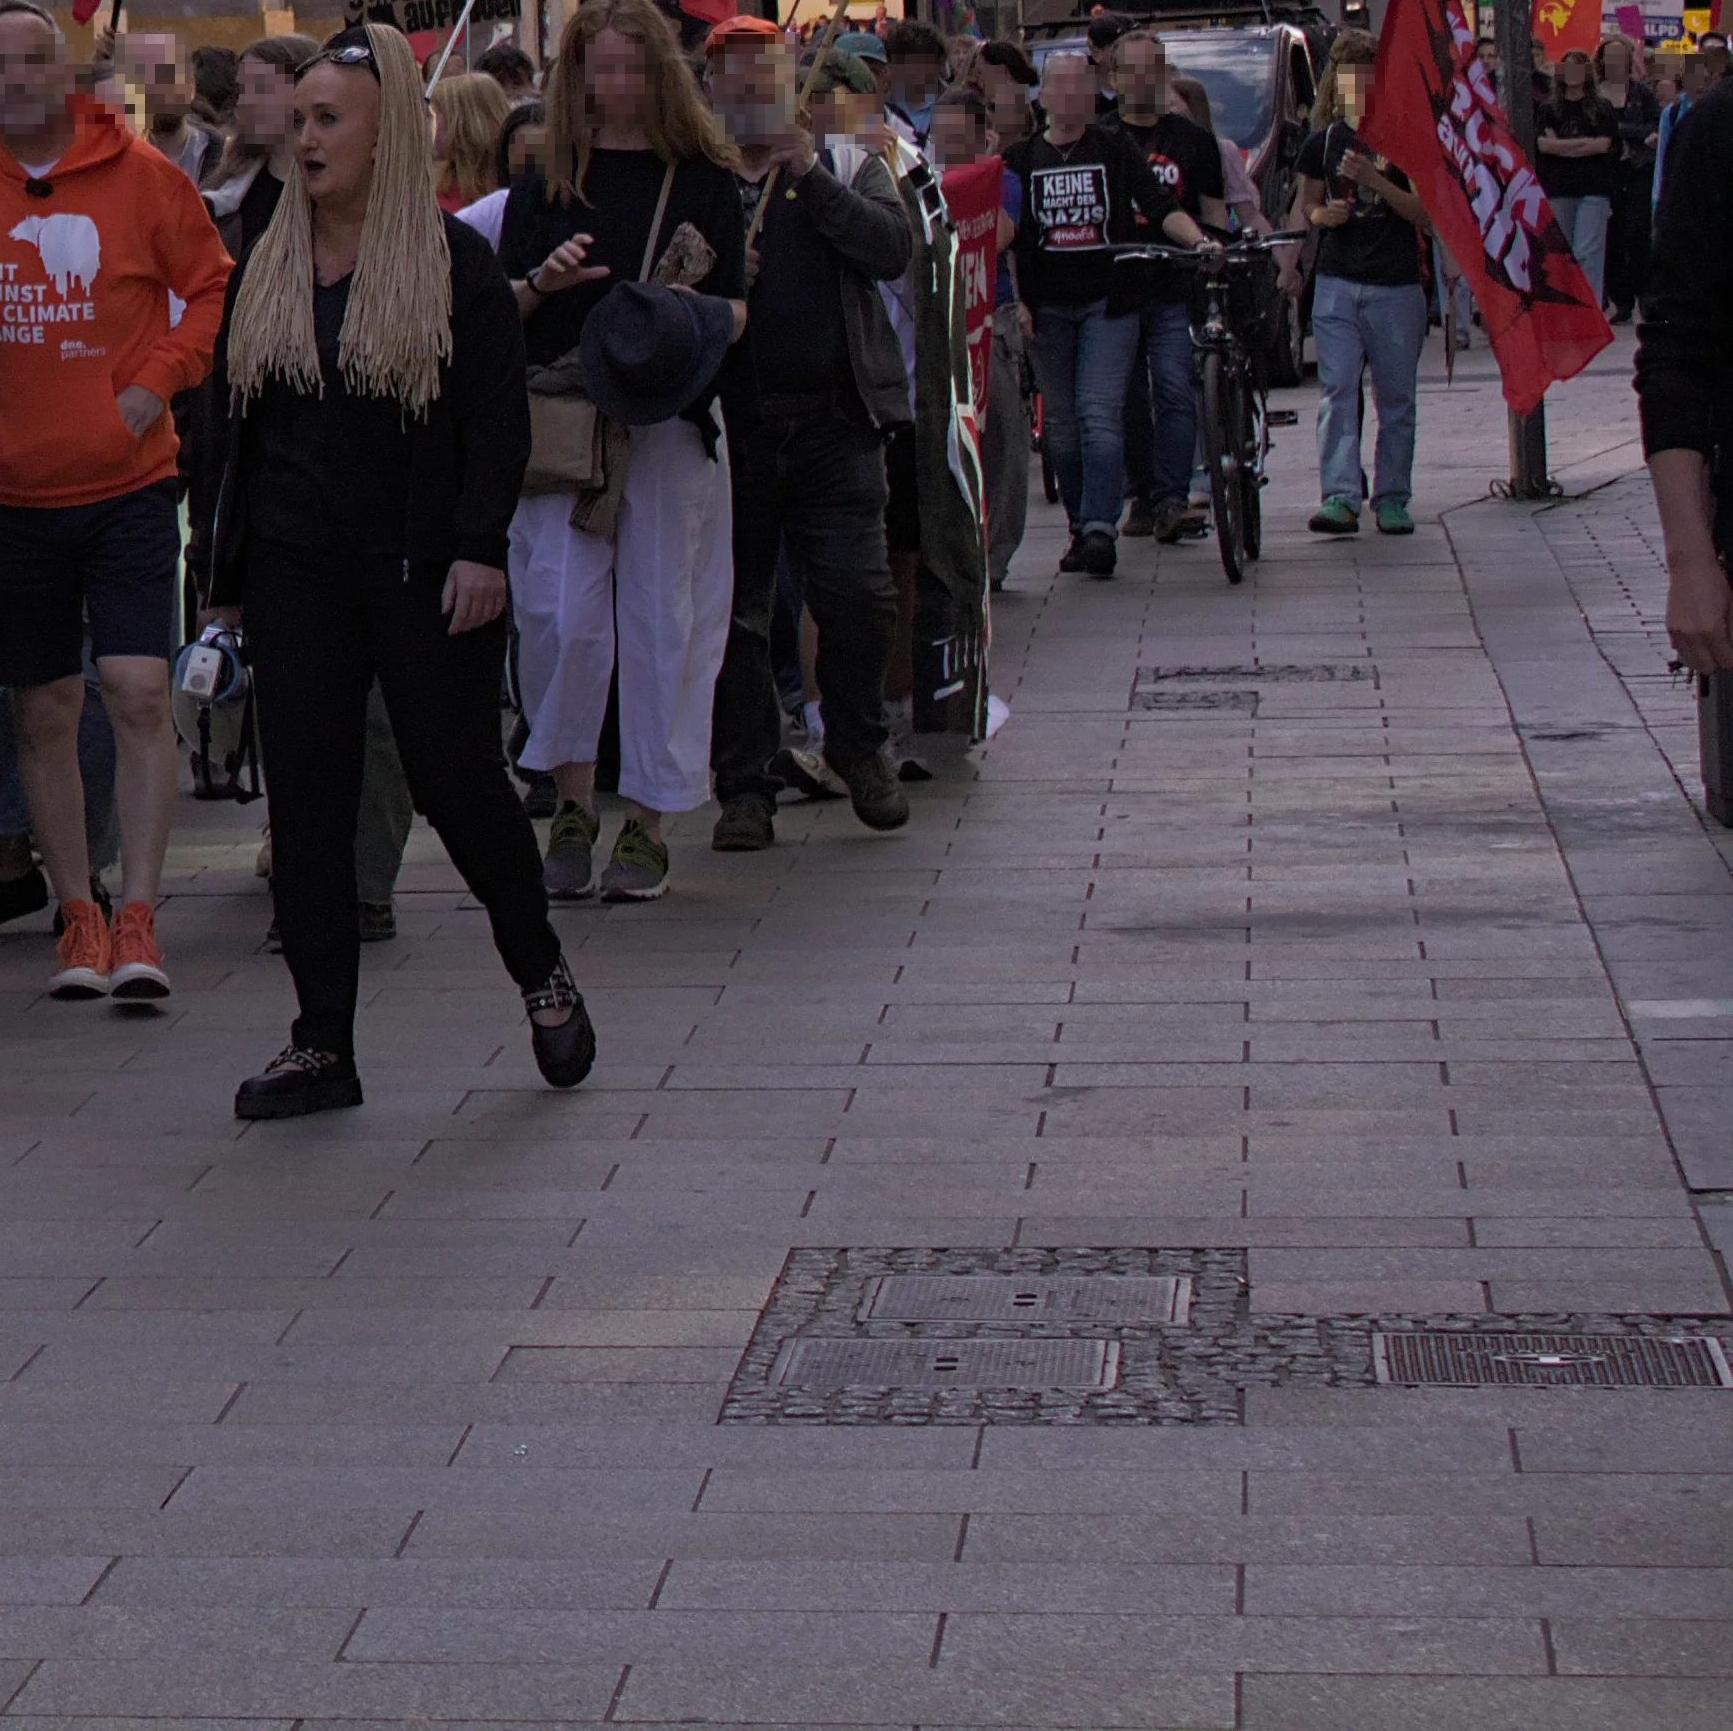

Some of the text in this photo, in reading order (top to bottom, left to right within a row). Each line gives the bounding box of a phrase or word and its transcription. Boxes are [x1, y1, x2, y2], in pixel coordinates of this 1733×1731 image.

[1043, 171, 1094, 196] KEINE
[1038, 204, 1105, 229] NAZIS
[3, 302, 96, 323] CLIMATE
